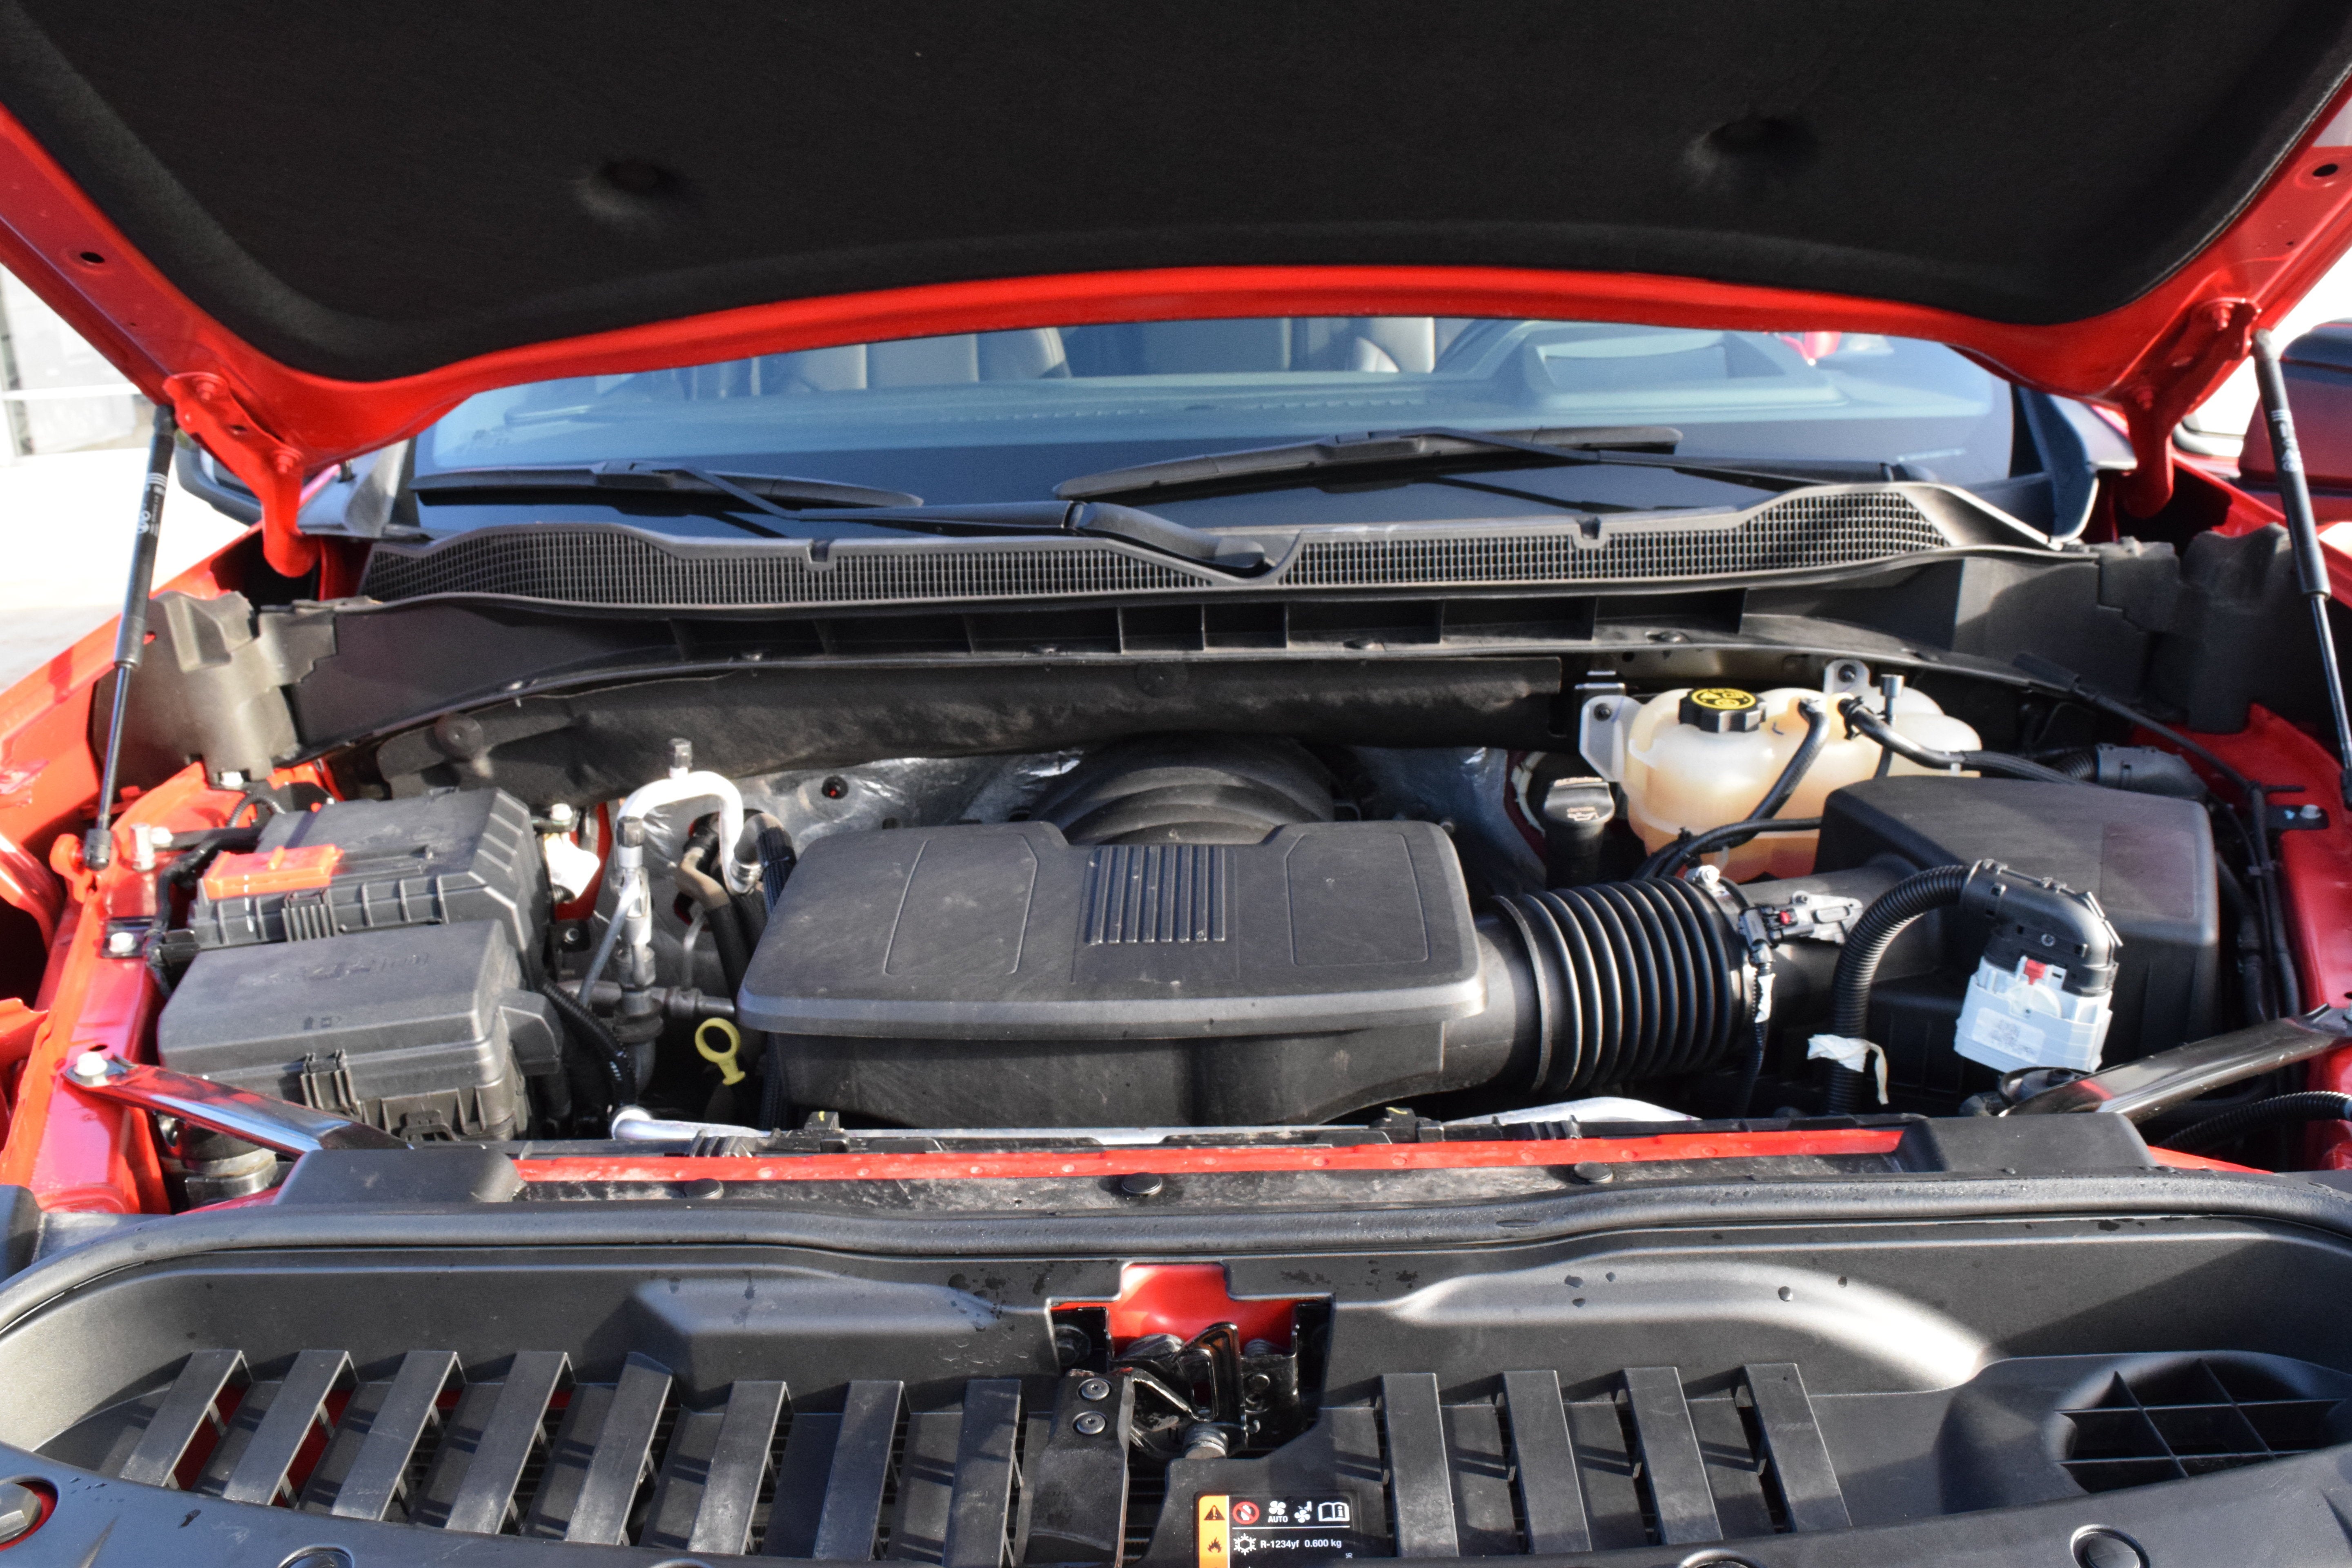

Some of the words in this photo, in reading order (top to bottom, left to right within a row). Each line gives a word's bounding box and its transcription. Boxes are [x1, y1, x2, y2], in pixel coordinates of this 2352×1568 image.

[1260, 1540, 1300, 1549] R-1234yf
[1304, 1539, 1329, 1548] 0.600
[1331, 1539, 1342, 1548] kg
